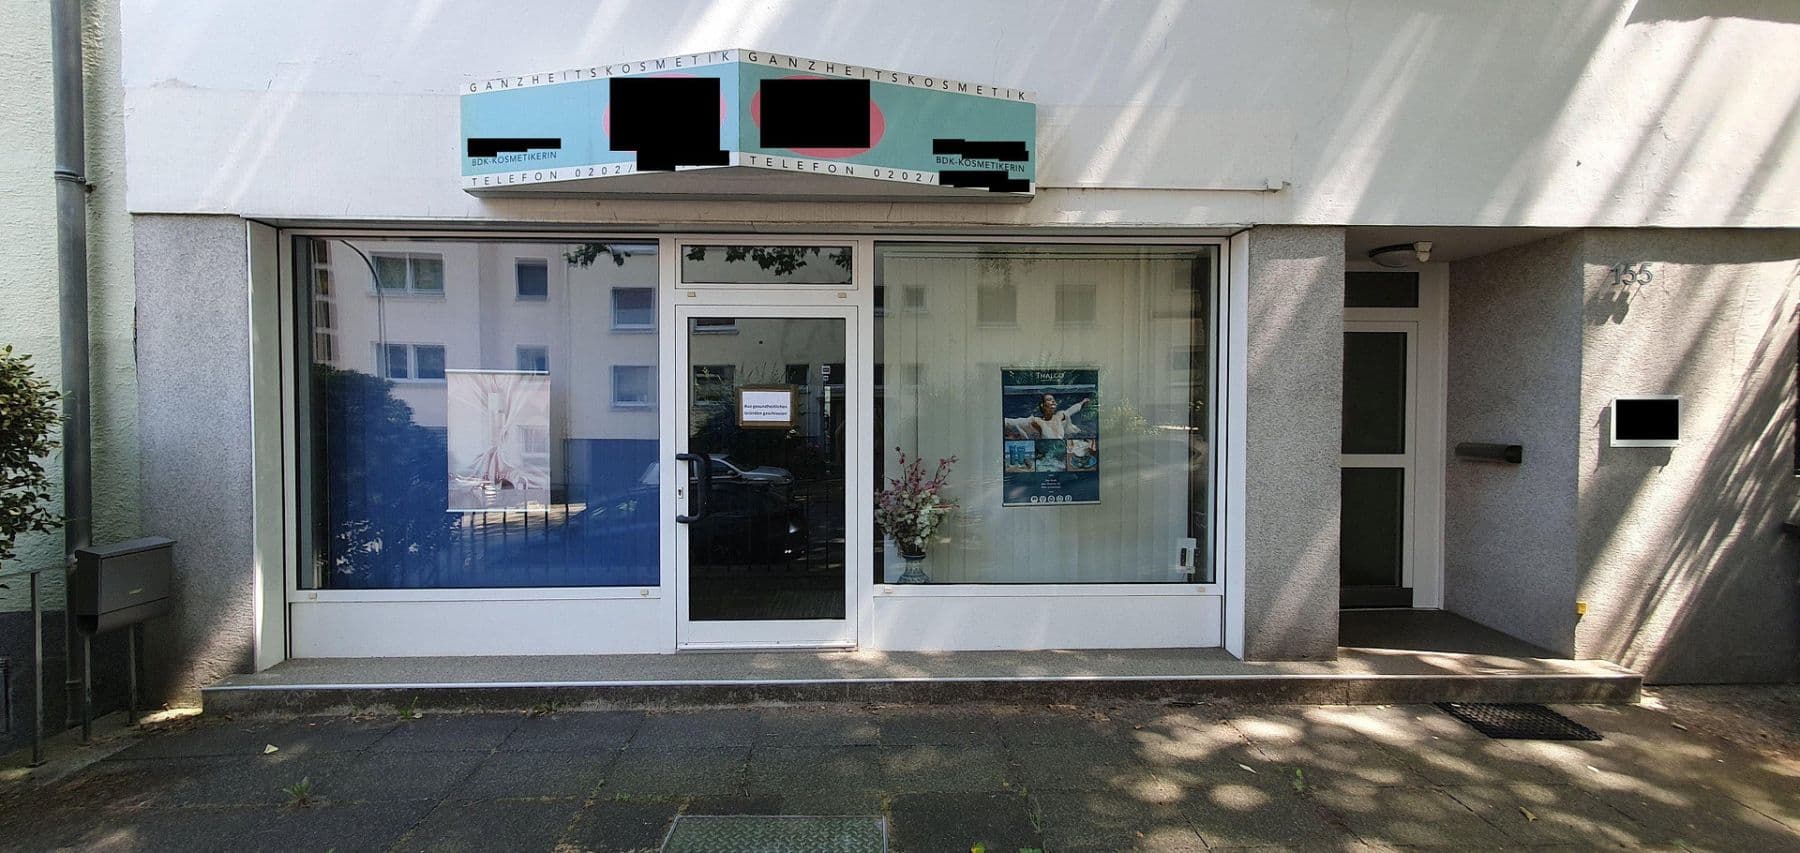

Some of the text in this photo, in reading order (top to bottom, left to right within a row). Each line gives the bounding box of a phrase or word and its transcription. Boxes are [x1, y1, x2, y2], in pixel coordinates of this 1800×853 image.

[469, 51, 730, 92] GANZHEITSKOSMETIK
[748, 51, 1026, 101] GANZHEITSKOSMETIK
[471, 151, 557, 167] BDK-KOSMETIKERIN
[750, 156, 934, 183] TELEFON 0202/
[935, 155, 1025, 173] BDK-KOSMETIKERIN
[472, 164, 633, 186] TELEFON 0202/
[1611, 262, 1653, 286] 155
